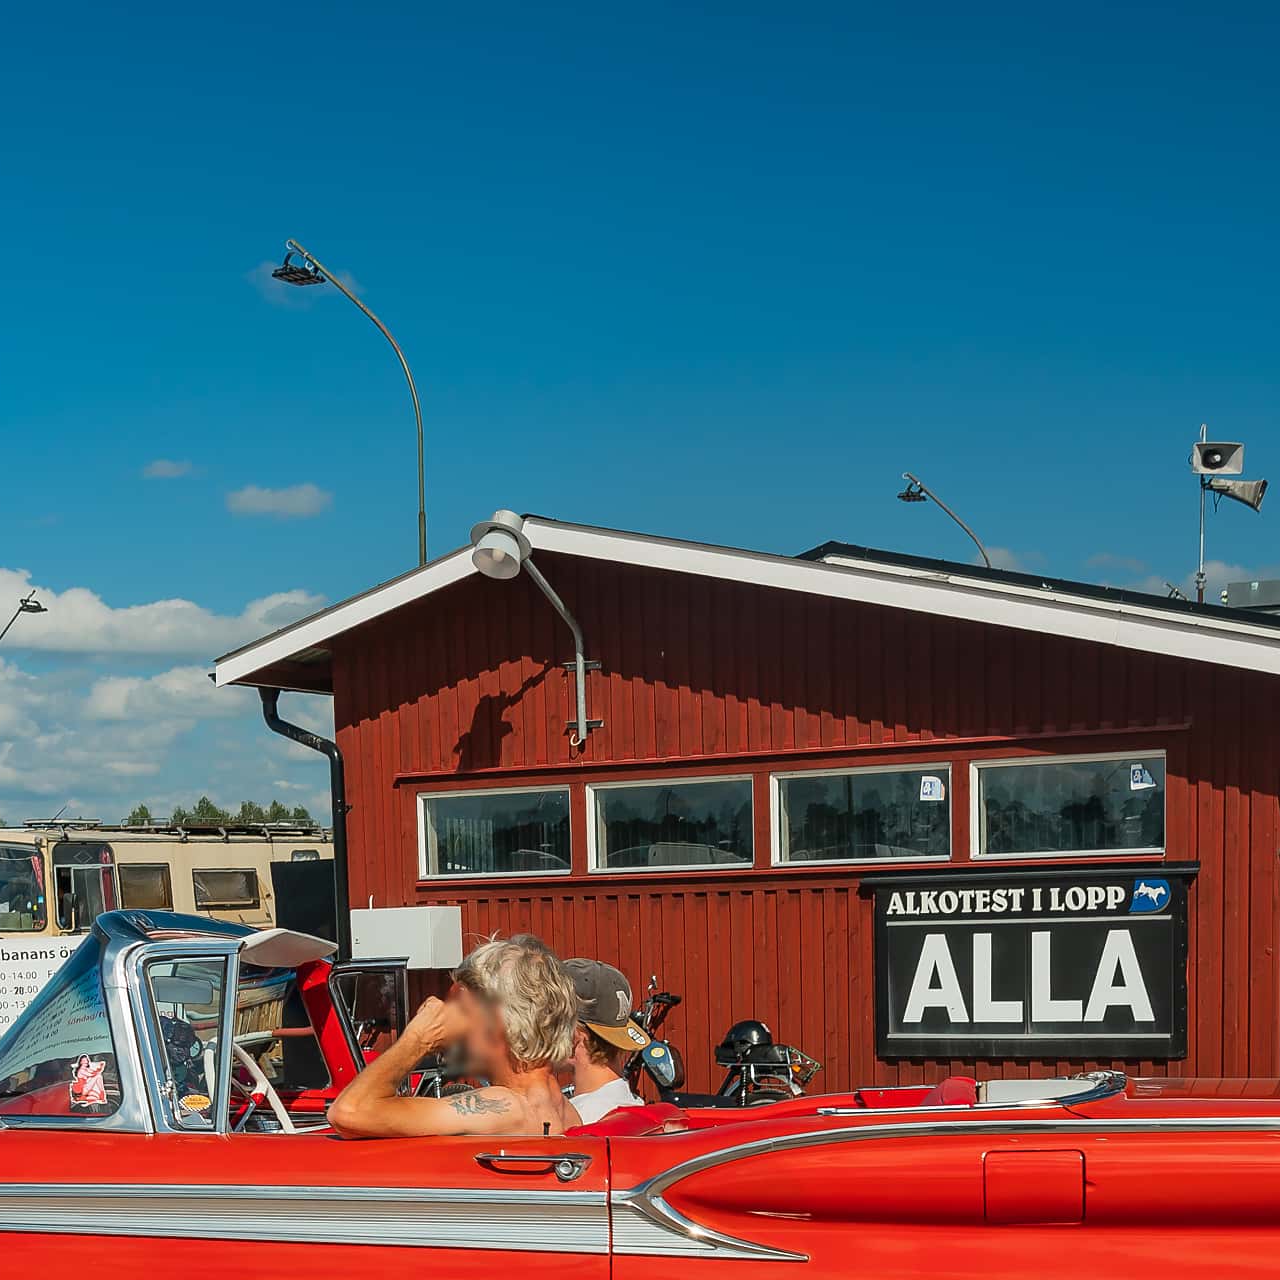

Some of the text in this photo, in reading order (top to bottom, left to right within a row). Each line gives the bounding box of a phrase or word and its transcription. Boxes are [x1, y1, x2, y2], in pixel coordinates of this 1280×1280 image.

[886, 886, 1126, 916] ALKOTEST I LOPP
[1, 948, 55, 962] banans
[902, 929, 1156, 1023] ALLA
